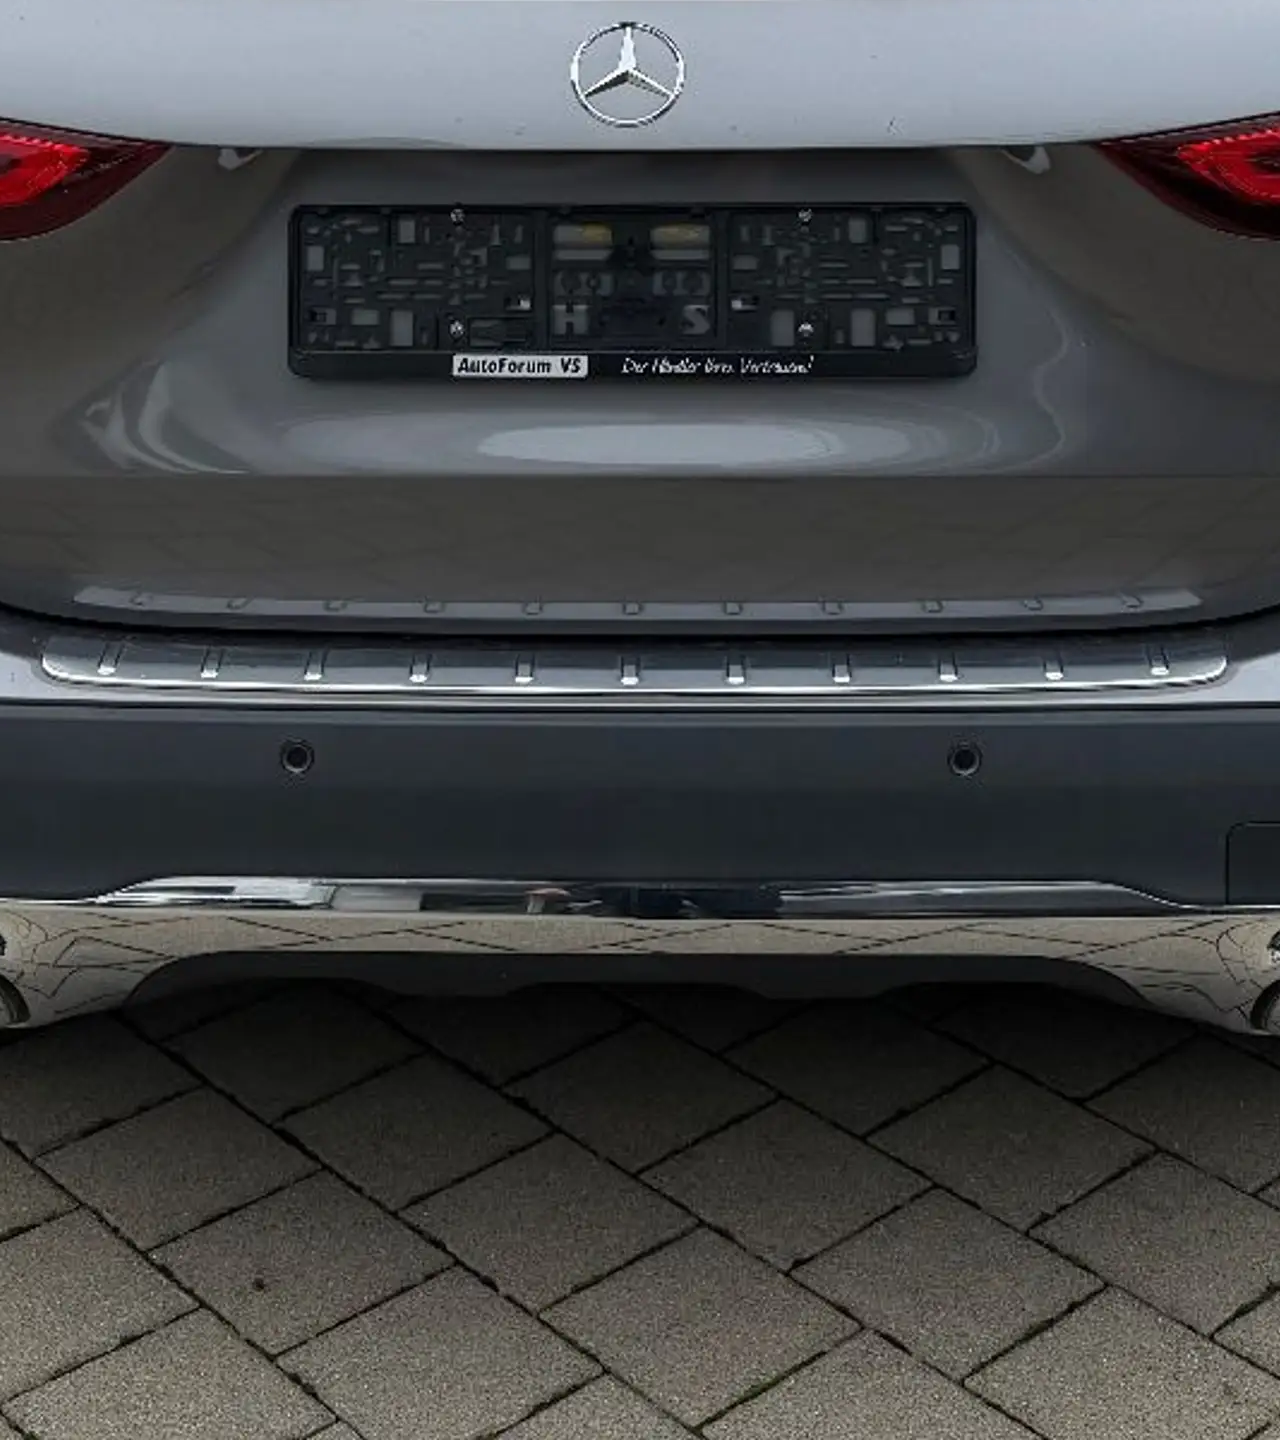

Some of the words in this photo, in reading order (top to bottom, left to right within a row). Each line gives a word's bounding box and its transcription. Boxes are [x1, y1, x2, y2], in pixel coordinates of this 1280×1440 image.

[457, 357, 552, 373] AutoForum
[560, 357, 581, 374] VS
[621, 357, 649, 374] Der
